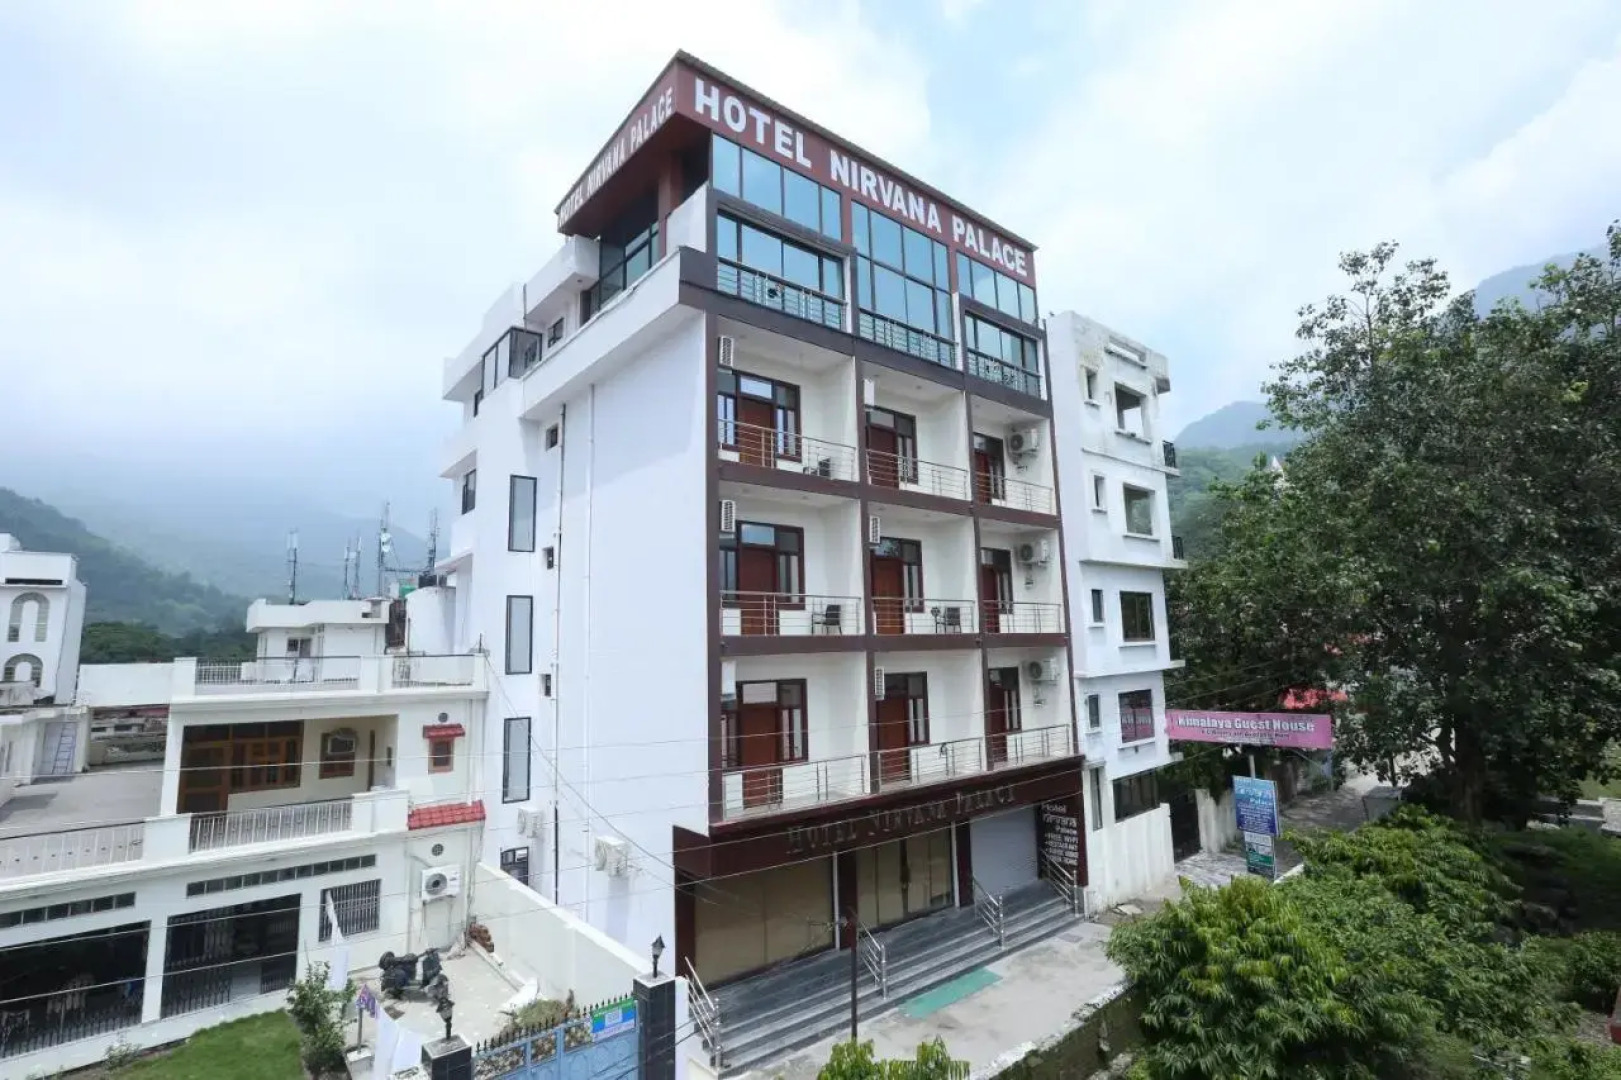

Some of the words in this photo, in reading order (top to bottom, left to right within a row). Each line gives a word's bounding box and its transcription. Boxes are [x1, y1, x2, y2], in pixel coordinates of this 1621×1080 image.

[631, 86, 673, 152] PALACE
[694, 77, 812, 169] HOTEL
[830, 149, 942, 234] NIRVANA
[951, 214, 1028, 277] PALACE
[1235, 717, 1270, 731] Guest
[1273, 718, 1315, 732] House
